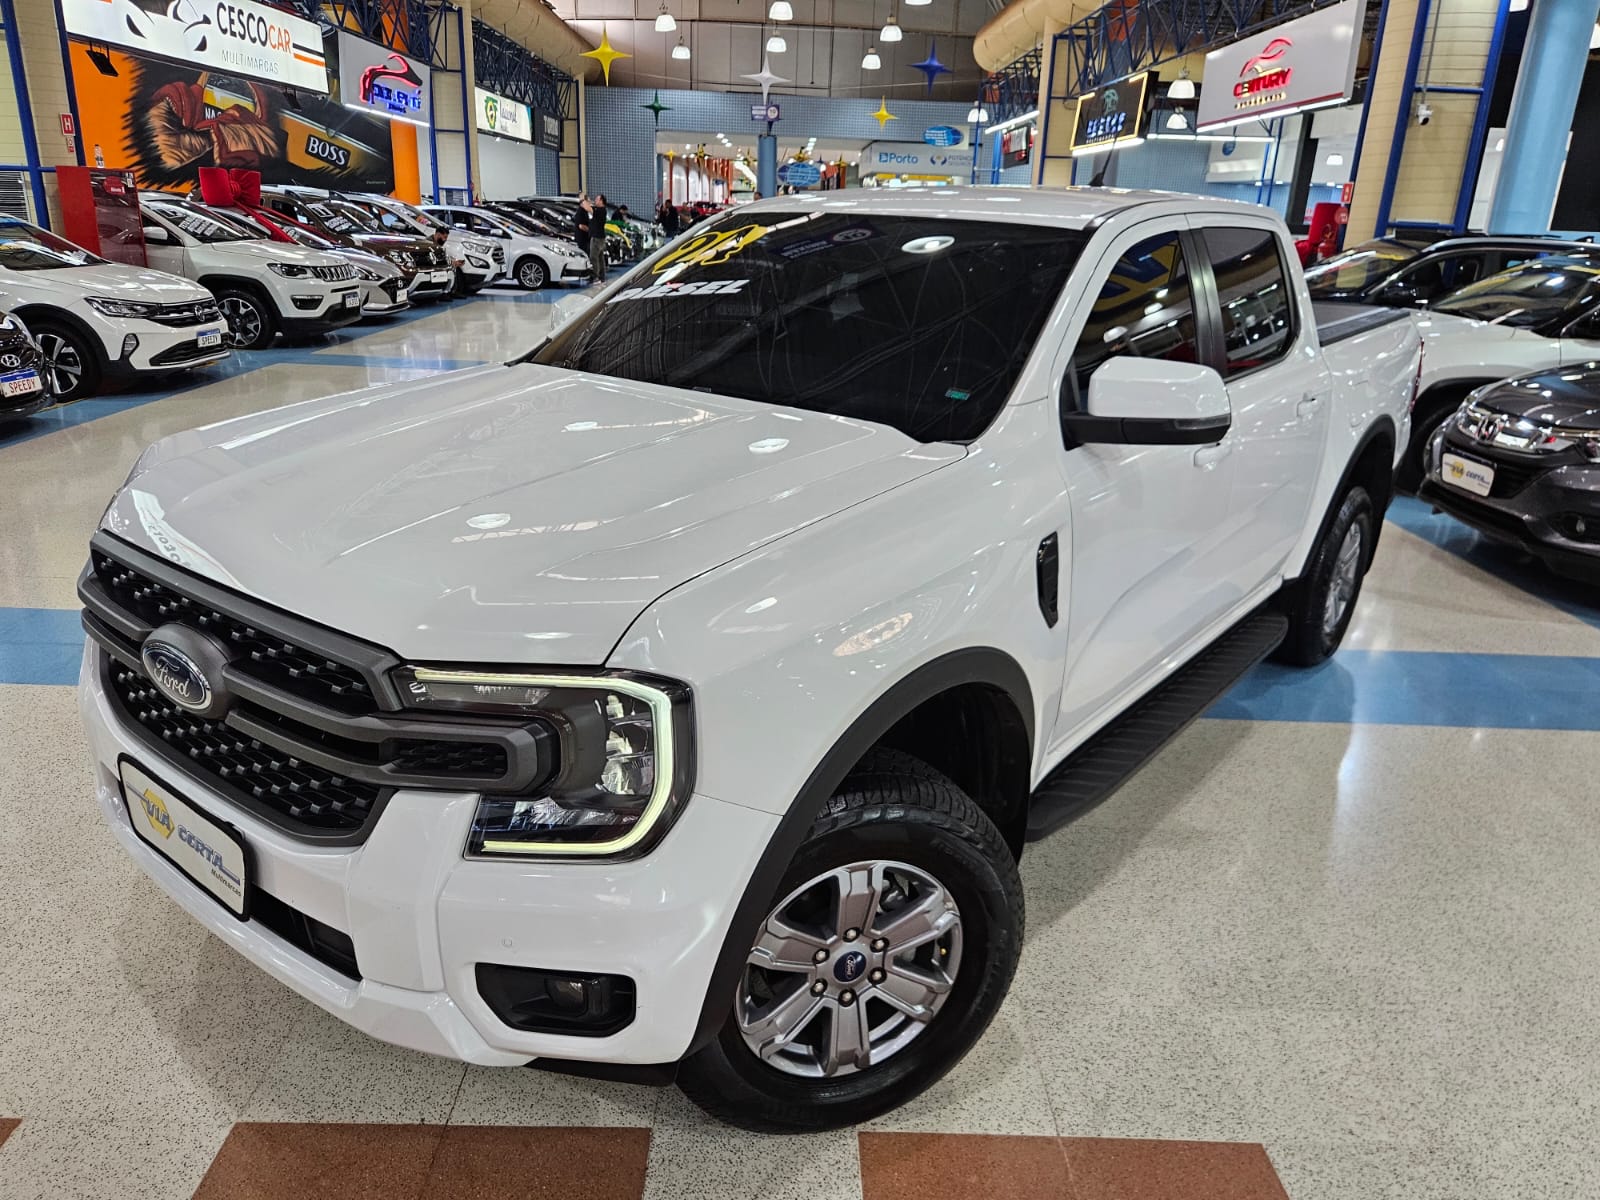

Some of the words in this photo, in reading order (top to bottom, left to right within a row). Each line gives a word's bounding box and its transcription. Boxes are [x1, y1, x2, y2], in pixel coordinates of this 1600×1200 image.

[216, 2, 292, 54] CESCOCAR
[221, 50, 280, 74] MULTIMARCAS
[1233, 67, 1293, 98] CENTURY
[63, 117, 72, 132] H
[308, 136, 348, 166] BOSS
[889, 152, 919, 165] Porto
[605, 279, 751, 304] DIESEL
[8, 377, 36, 394] SPEEDY
[153, 655, 191, 698] Ford
[146, 799, 171, 832] VIA
[177, 824, 224, 871] CERTA
